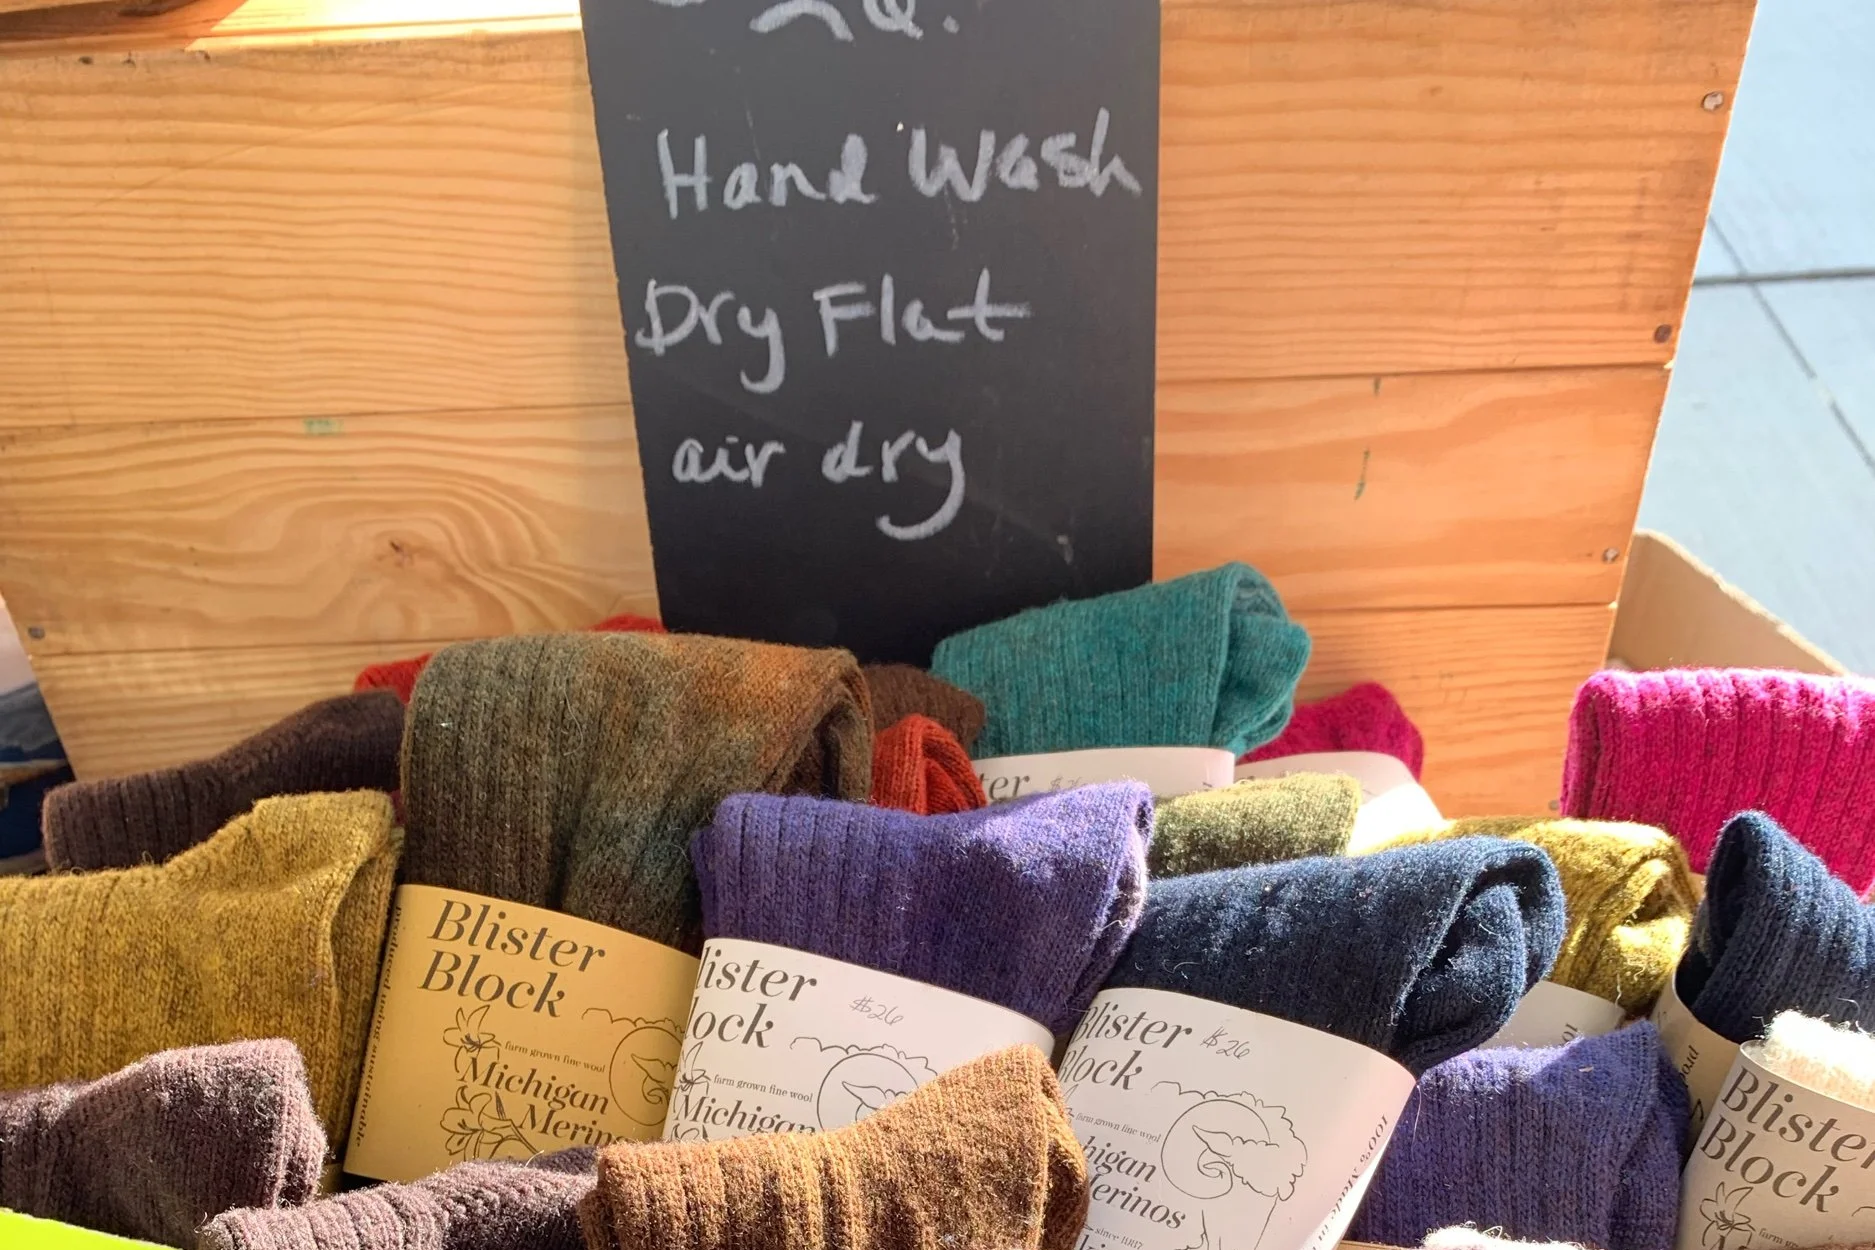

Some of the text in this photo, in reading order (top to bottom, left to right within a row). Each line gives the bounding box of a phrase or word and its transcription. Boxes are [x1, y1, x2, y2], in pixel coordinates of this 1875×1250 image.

[657, 106, 1143, 219] Hand Wash
[635, 267, 1031, 394] Dry Flat
[671, 421, 963, 540] air dry
[427, 899, 606, 973] Blister
[417, 949, 566, 1018] Block
[696, 946, 817, 1001] lister
[685, 996, 774, 1048] lock
[1070, 1001, 1192, 1048] Blister
[459, 1057, 609, 1115] Michigan
[584, 1062, 606, 1073] wool
[714, 1074, 814, 1103] farm grown fine wool
[516, 1103, 622, 1147] Merin
[1083, 1136, 1156, 1182] higan
[1700, 1115, 1839, 1213] Block
[1090, 1174, 1186, 1229] erinos
[1758, 1228, 1783, 1245] farm
